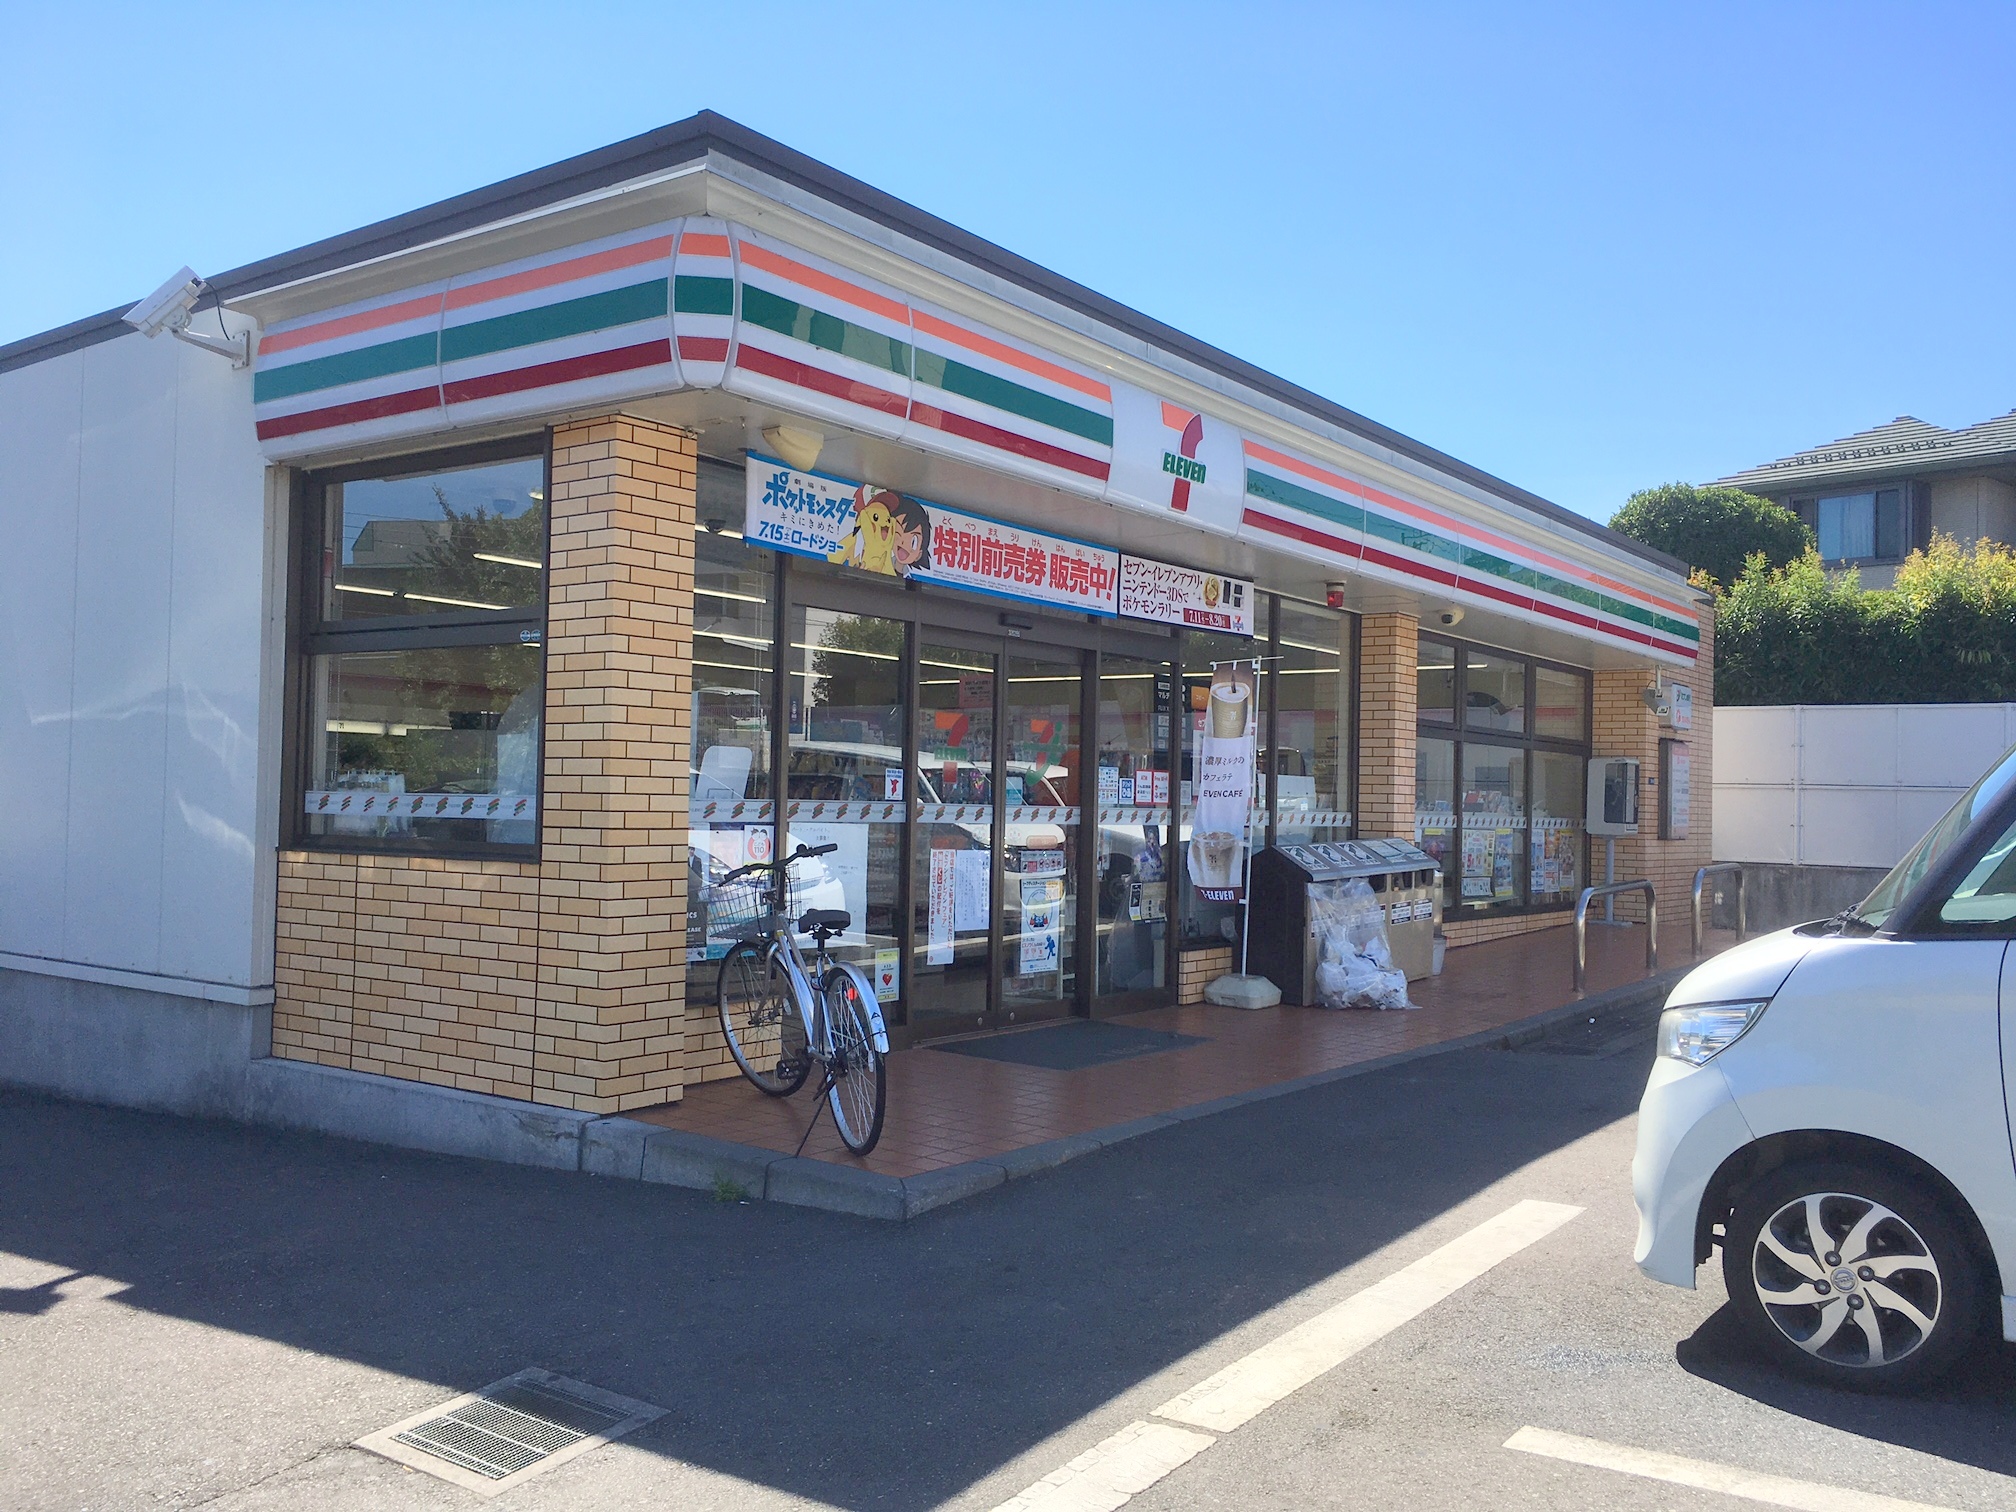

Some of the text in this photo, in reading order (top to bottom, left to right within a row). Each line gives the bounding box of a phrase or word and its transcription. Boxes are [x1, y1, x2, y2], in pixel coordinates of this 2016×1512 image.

[794, 479, 827, 492] 劇場版
[762, 472, 857, 525] ポケットモンスター
[933, 525, 1047, 586] 特別前売券
[1123, 595, 1180, 618] ポケモンラリー
[1205, 755, 1245, 766] 濃厚ミルクの
[1203, 773, 1233, 782] カフェラテ
[754, 846, 765, 854] 110
